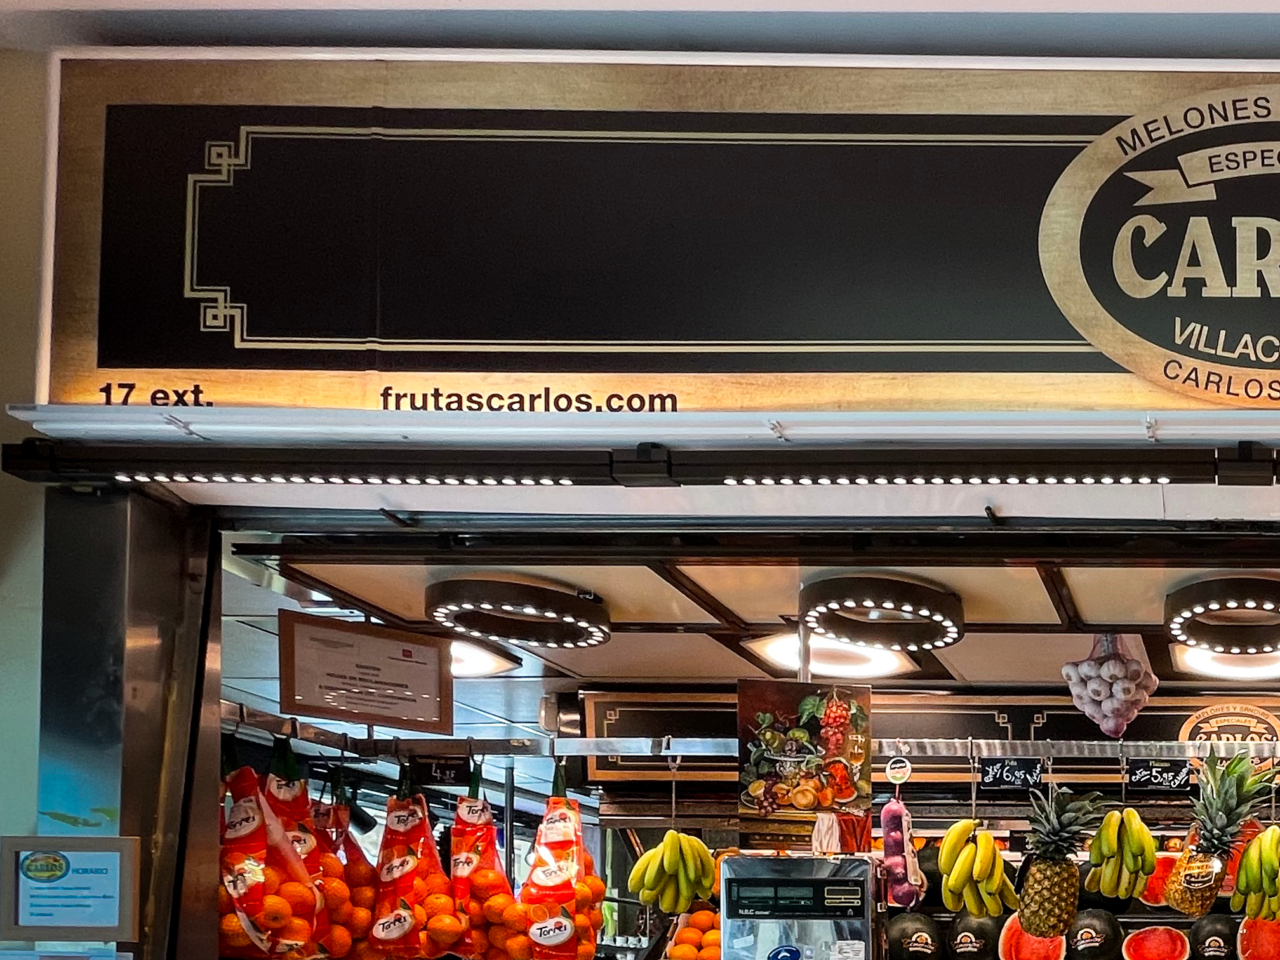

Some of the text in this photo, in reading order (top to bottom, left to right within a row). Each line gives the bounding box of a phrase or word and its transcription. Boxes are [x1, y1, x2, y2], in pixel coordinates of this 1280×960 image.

[1115, 96, 1272, 157] MELONES
[98, 382, 215, 407] 17 ext.
[380, 385, 679, 413] frutascarlos.com
[1002, 766, 1025, 783] 6,95
[1151, 768, 1175, 783] 5,95
[378, 914, 408, 933] Torres
[535, 922, 568, 939] Torres
